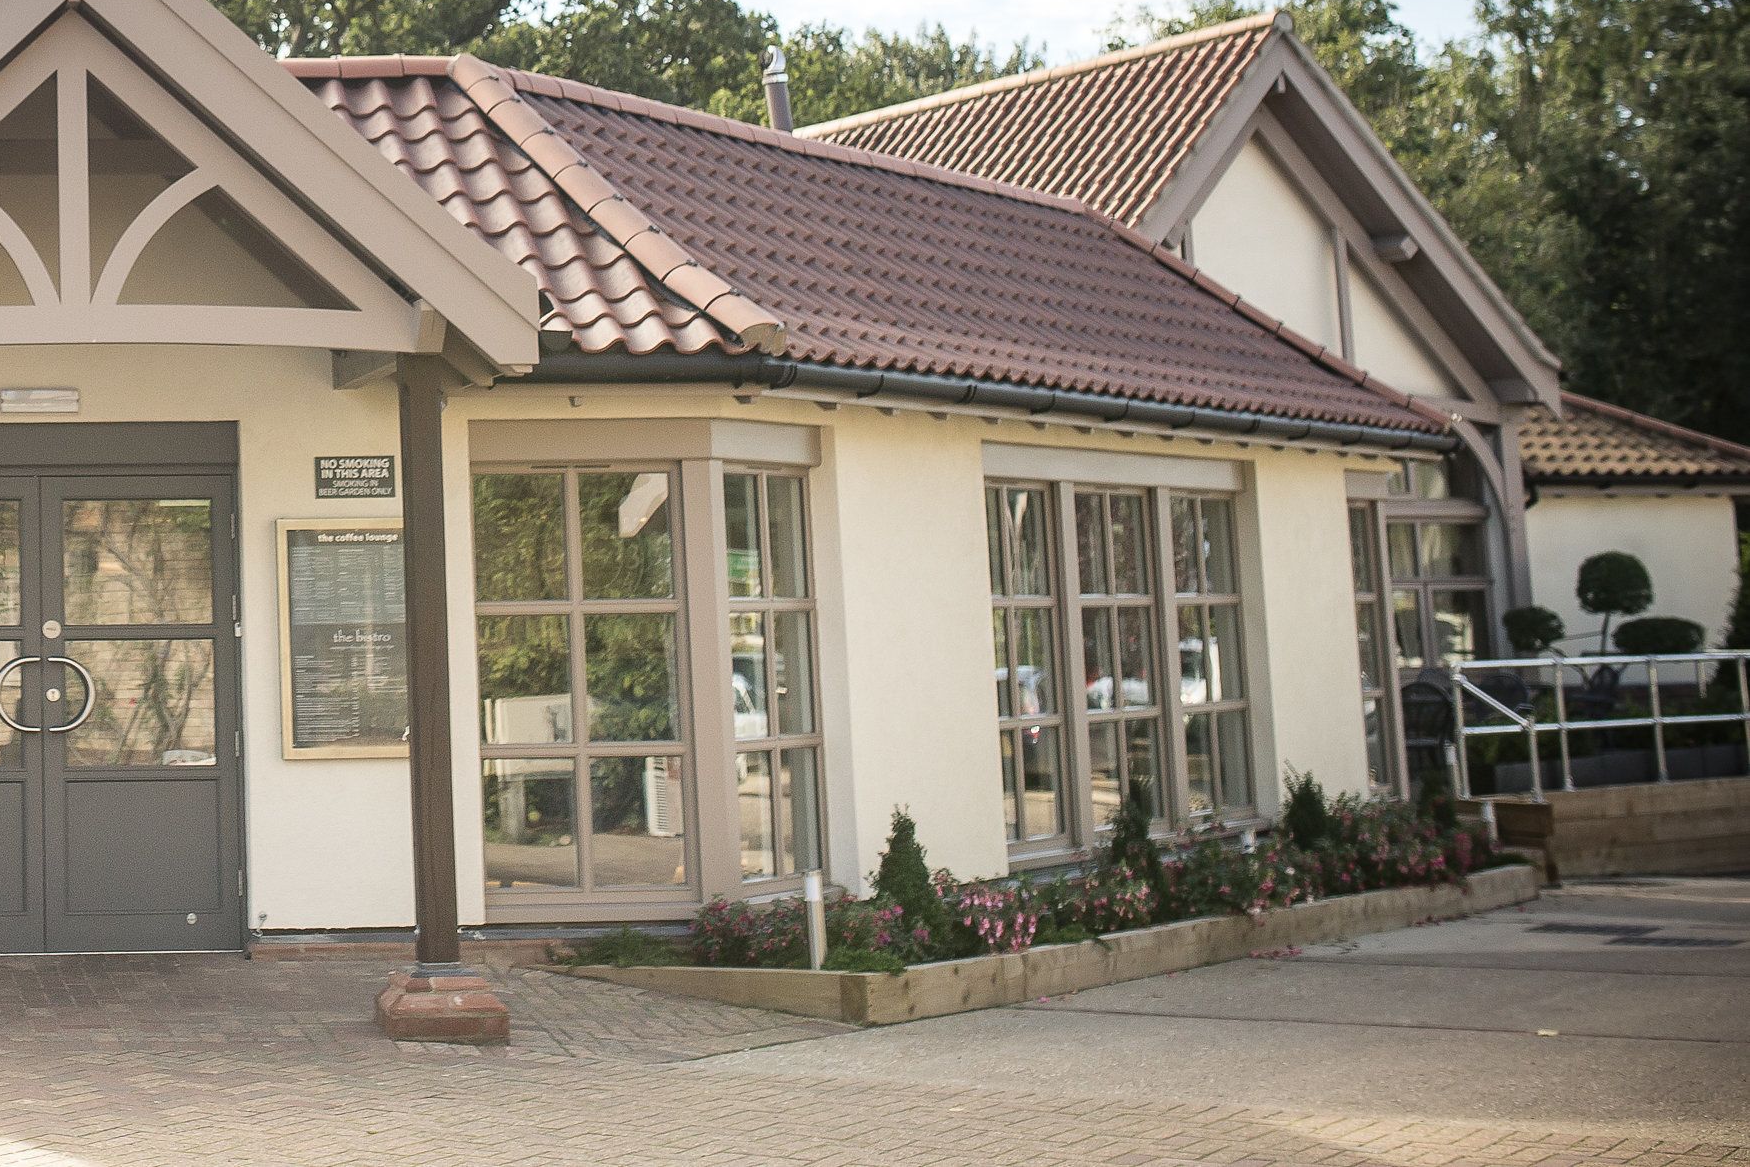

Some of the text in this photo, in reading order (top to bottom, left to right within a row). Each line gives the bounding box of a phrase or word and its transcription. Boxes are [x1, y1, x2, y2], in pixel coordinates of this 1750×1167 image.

[320, 458, 390, 469] NO SMOKING
[321, 468, 389, 479] IN THIS AREA
[332, 479, 379, 488] SMOKING IN
[318, 487, 393, 496] BEER GARDEN ONLY
[317, 532, 399, 543] the coffee lounge
[333, 628, 392, 643] the bistro
